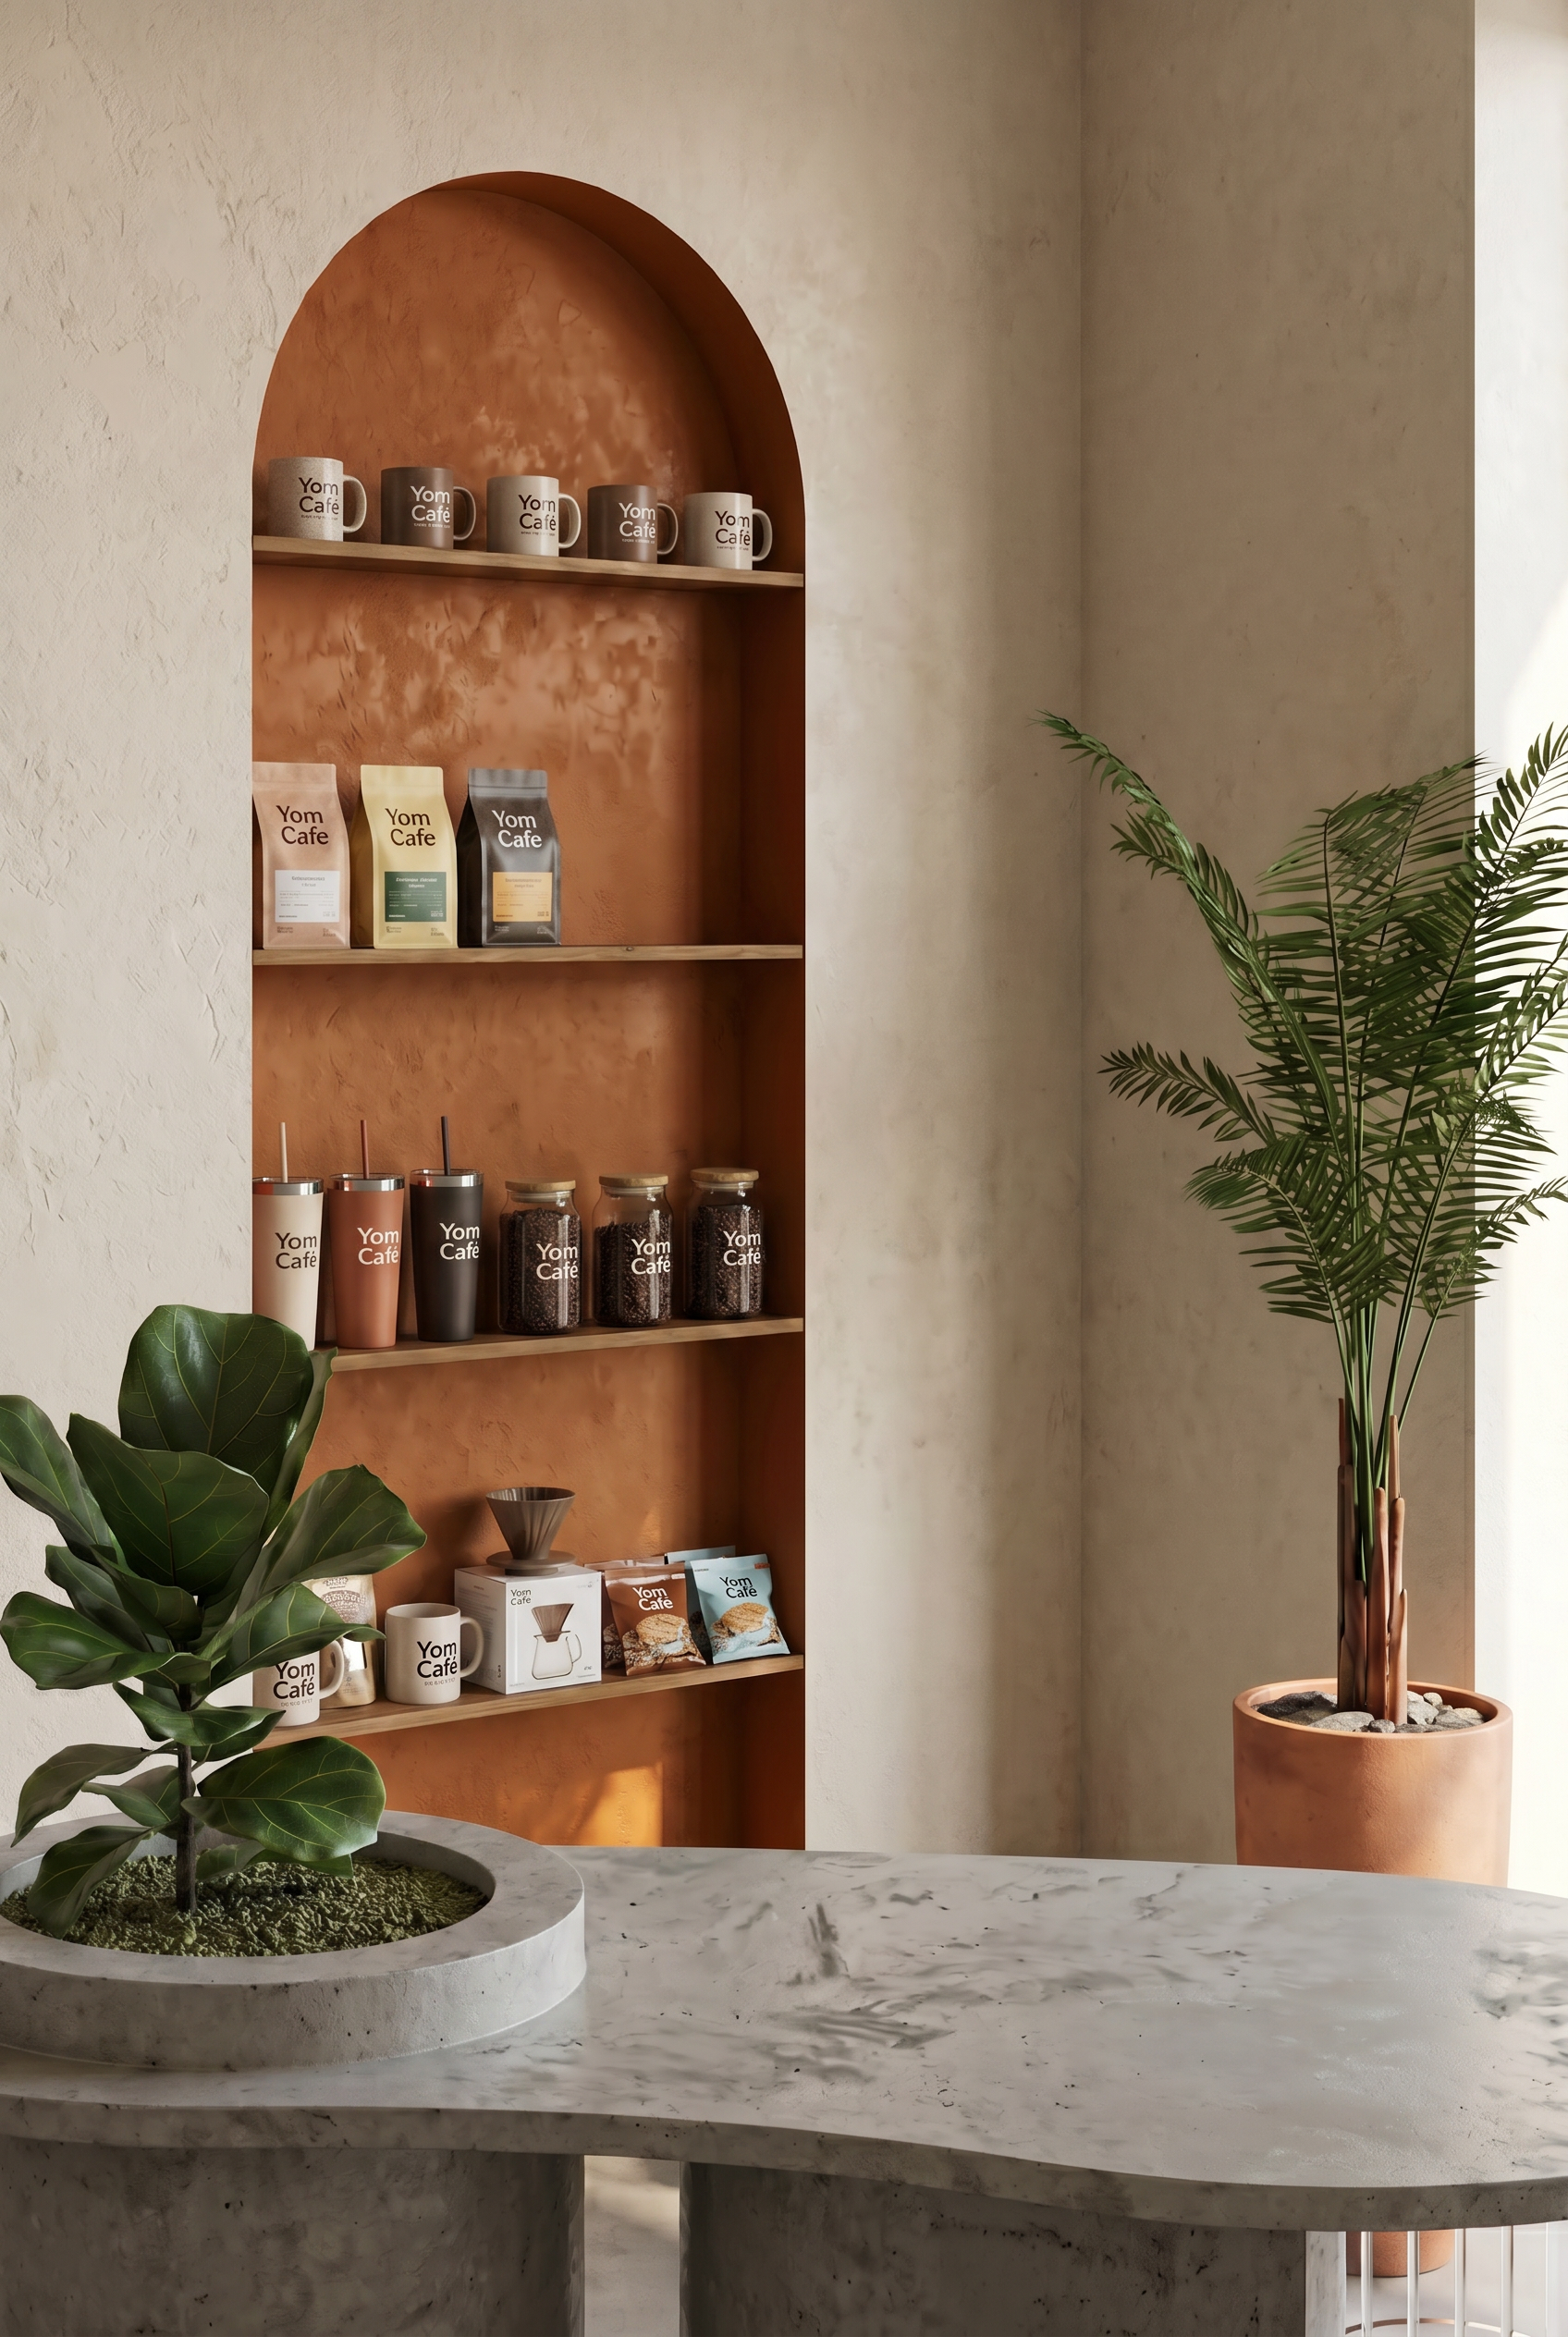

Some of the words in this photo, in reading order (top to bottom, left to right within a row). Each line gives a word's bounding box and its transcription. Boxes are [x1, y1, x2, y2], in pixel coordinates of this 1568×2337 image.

[298, 476, 338, 496] Yom
[410, 485, 450, 504] Yom
[299, 496, 339, 515] Café
[518, 495, 556, 513] Yom
[619, 502, 655, 520] Yom
[411, 506, 451, 523] Café
[519, 513, 557, 532] Café
[715, 510, 750, 528] Yom
[619, 521, 656, 539] Café
[715, 529, 751, 546] Café
[276, 805, 324, 824] Yom
[385, 808, 432, 826] Yom
[491, 810, 537, 828] Yom
[281, 826, 329, 845] Cafe
[390, 827, 436, 847] Cafe
[497, 829, 543, 849] Cafe
[357, 1227, 399, 1245] Yom
[439, 1222, 480, 1240] Yom
[723, 1230, 761, 1247] Yom
[275, 1232, 317, 1250] Yom
[631, 1238, 671, 1255] Yom
[358, 1246, 398, 1266] Café
[439, 1241, 480, 1260] Café
[536, 1242, 578, 1260] Yom
[723, 1247, 761, 1266] Café
[276, 1251, 317, 1269] Café
[631, 1254, 671, 1275] Café
[536, 1260, 579, 1280] Café
[719, 1576, 753, 1587] Yom
[632, 1586, 668, 1598] Yom
[510, 1597, 532, 1606] Cafe
[416, 1641, 457, 1659] Yom
[275, 1661, 315, 1680] Yom
[416, 1656, 458, 1680] Café
[273, 1677, 315, 1699] Café
